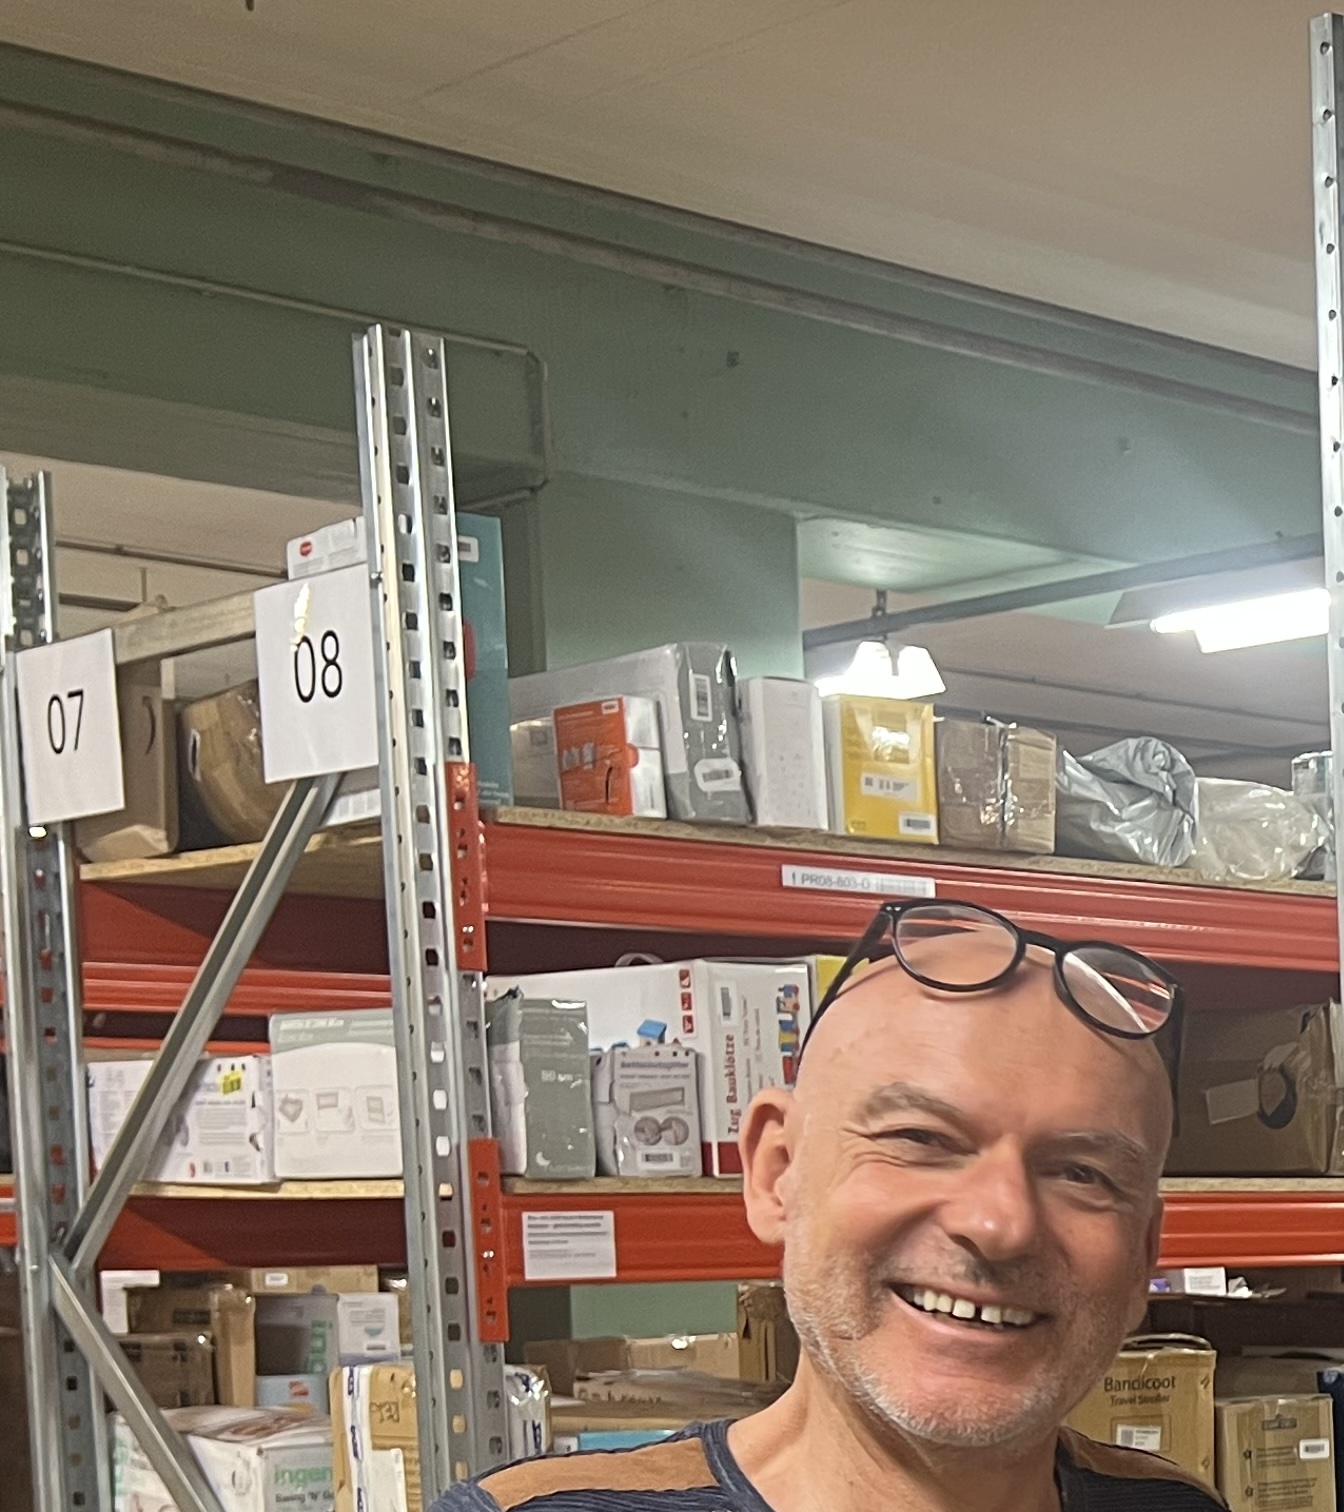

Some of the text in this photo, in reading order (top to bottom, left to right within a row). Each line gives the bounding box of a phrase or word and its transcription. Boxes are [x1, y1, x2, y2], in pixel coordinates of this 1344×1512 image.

[293, 629, 342, 703] 08
[46, 688, 84, 755] 07
[727, 1109, 742, 1134] Zug
[1104, 1376, 1176, 1392] Bandicoot
